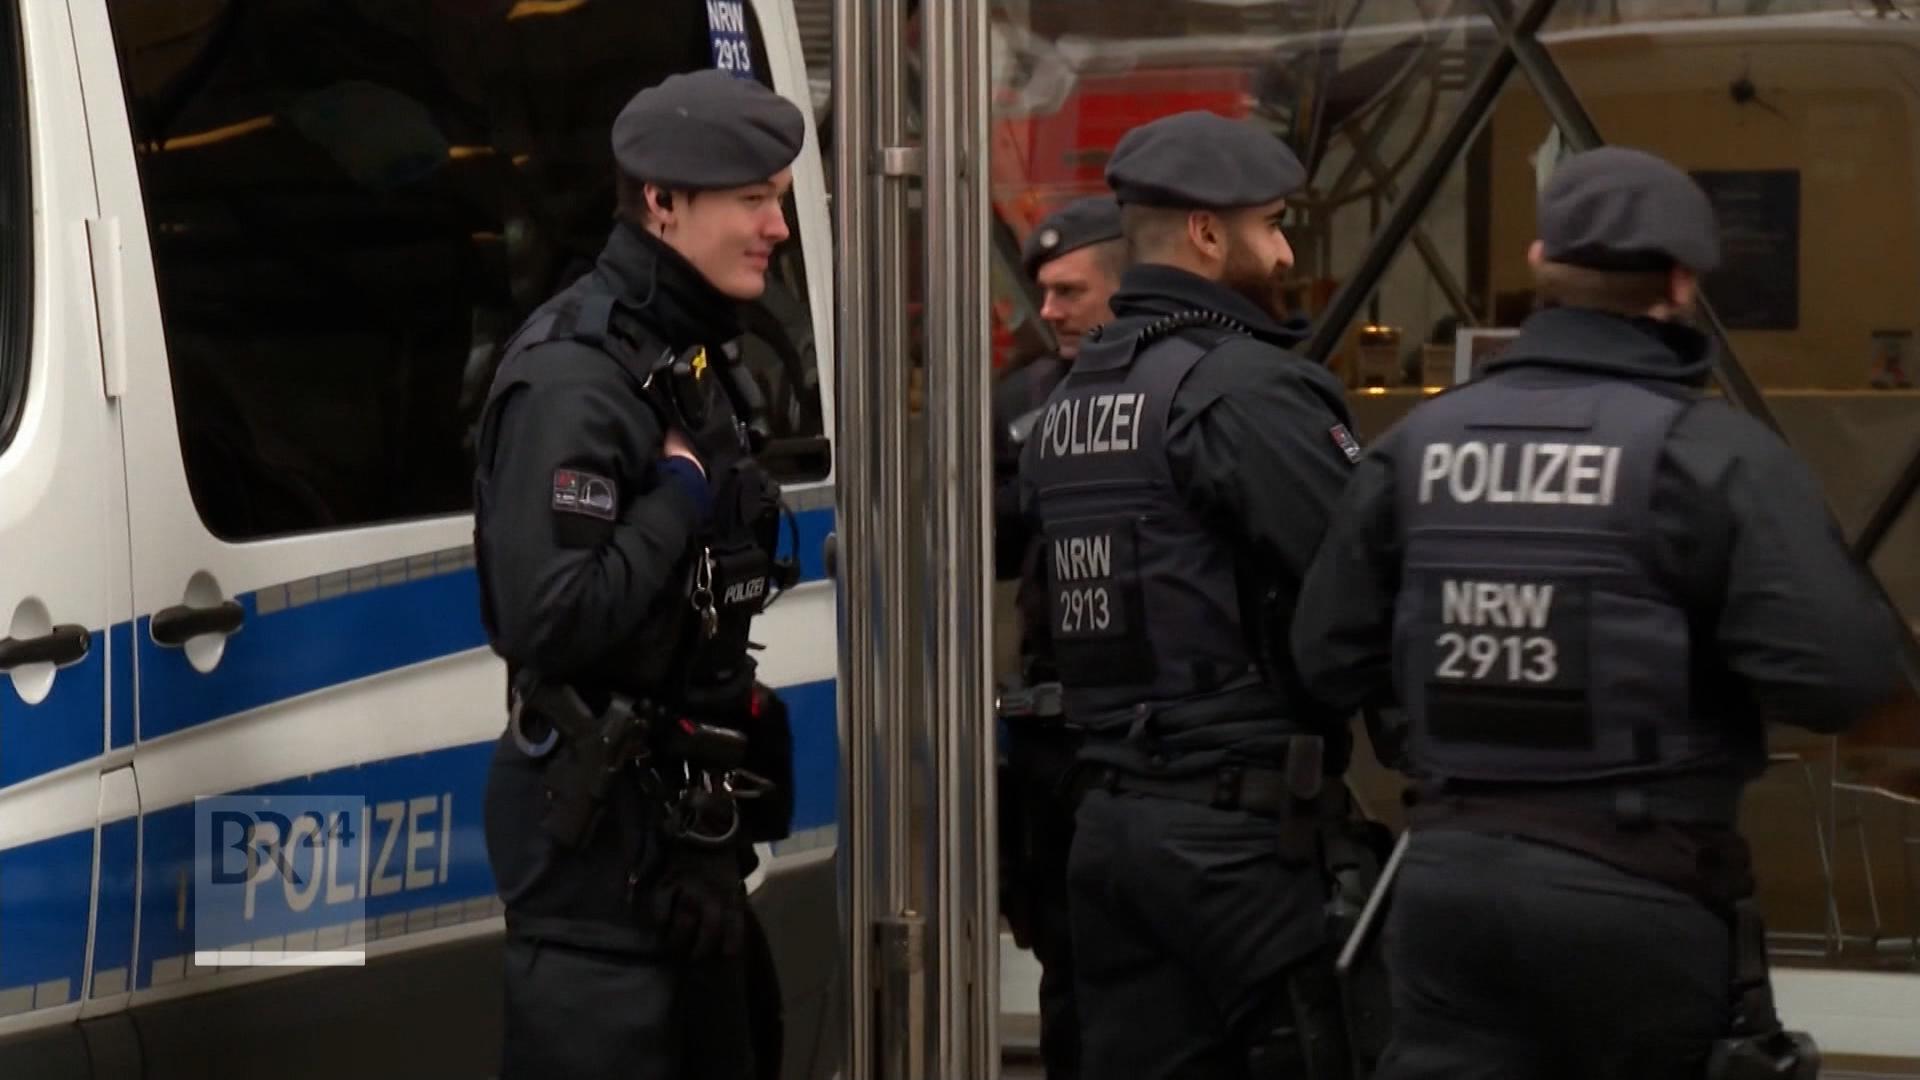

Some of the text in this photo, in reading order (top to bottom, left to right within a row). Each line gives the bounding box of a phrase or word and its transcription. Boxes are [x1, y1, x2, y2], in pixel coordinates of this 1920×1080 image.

[706, 0, 744, 32] NRW
[714, 38, 751, 71] 2913
[1040, 393, 1145, 459] POLIZEI
[1419, 441, 1622, 505] POLIZEI
[1055, 535, 1111, 580] NRW
[724, 577, 765, 604] POLIZEI
[1060, 588, 1110, 632] 2913
[1442, 580, 1553, 629] NRW
[1435, 632, 1558, 682] 2913
[244, 793, 452, 921] POLIZEI
